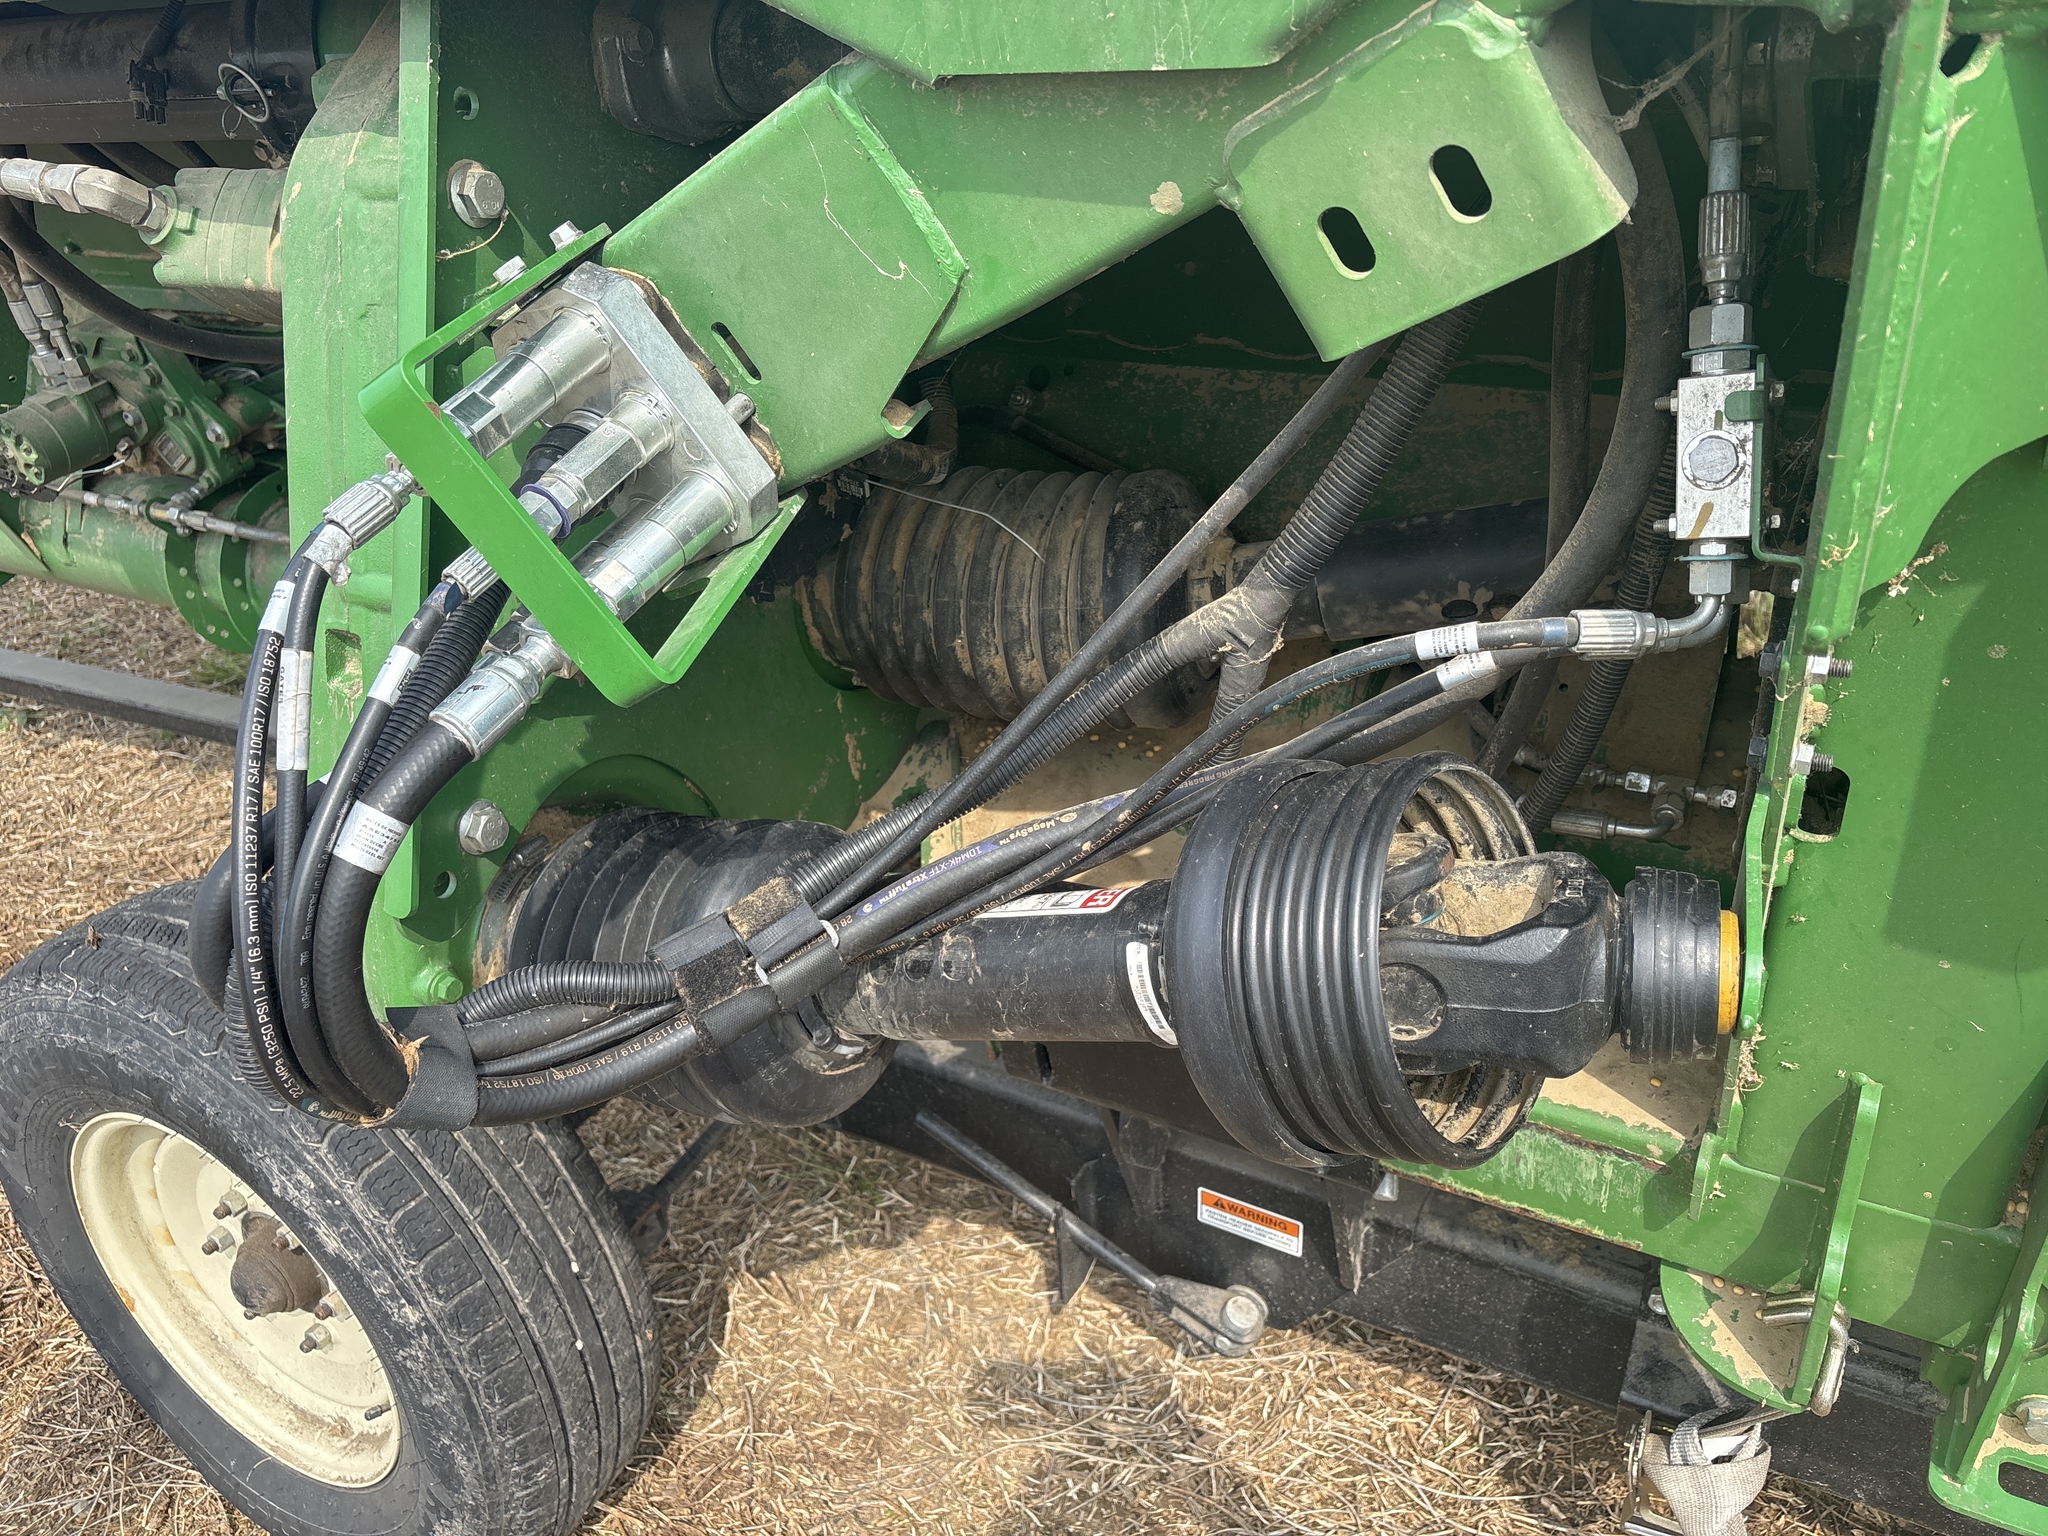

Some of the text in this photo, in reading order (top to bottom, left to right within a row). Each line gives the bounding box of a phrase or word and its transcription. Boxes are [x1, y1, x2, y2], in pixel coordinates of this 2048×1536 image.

[262, 635, 281, 676] 18752
[257, 676, 271, 698] ISO
[260, 699, 269, 708] /
[250, 706, 267, 756] 100R17
[247, 758, 261, 784] SAE
[1179, 773, 1215, 789] PROGRES
[246, 786, 260, 794] /
[246, 796, 259, 823] R17
[999, 818, 1056, 846] MegaSys™
[245, 826, 258, 869] 11237
[929, 845, 983, 877] 10M4K-XTF
[245, 873, 258, 896] ISO
[878, 871, 928, 905] XtraTuff™
[244, 900, 259, 931] mm)
[247, 935, 263, 963] (6.3
[250, 966, 265, 995] 1/4"
[254, 995, 270, 1024] PSI)
[673, 1015, 692, 1030] ISO
[261, 1023, 282, 1060] (3250
[643, 1026, 674, 1047] 11237
[593, 1055, 614, 1069] SAE
[614, 1051, 619, 1060] /
[620, 1042, 642, 1057] R19
[275, 1057, 291, 1081] MPa
[527, 1076, 544, 1086] ISO
[283, 1078, 304, 1099] 22.5
[493, 1078, 526, 1089] 18752
[1227, 1202, 1287, 1231] WARNING
